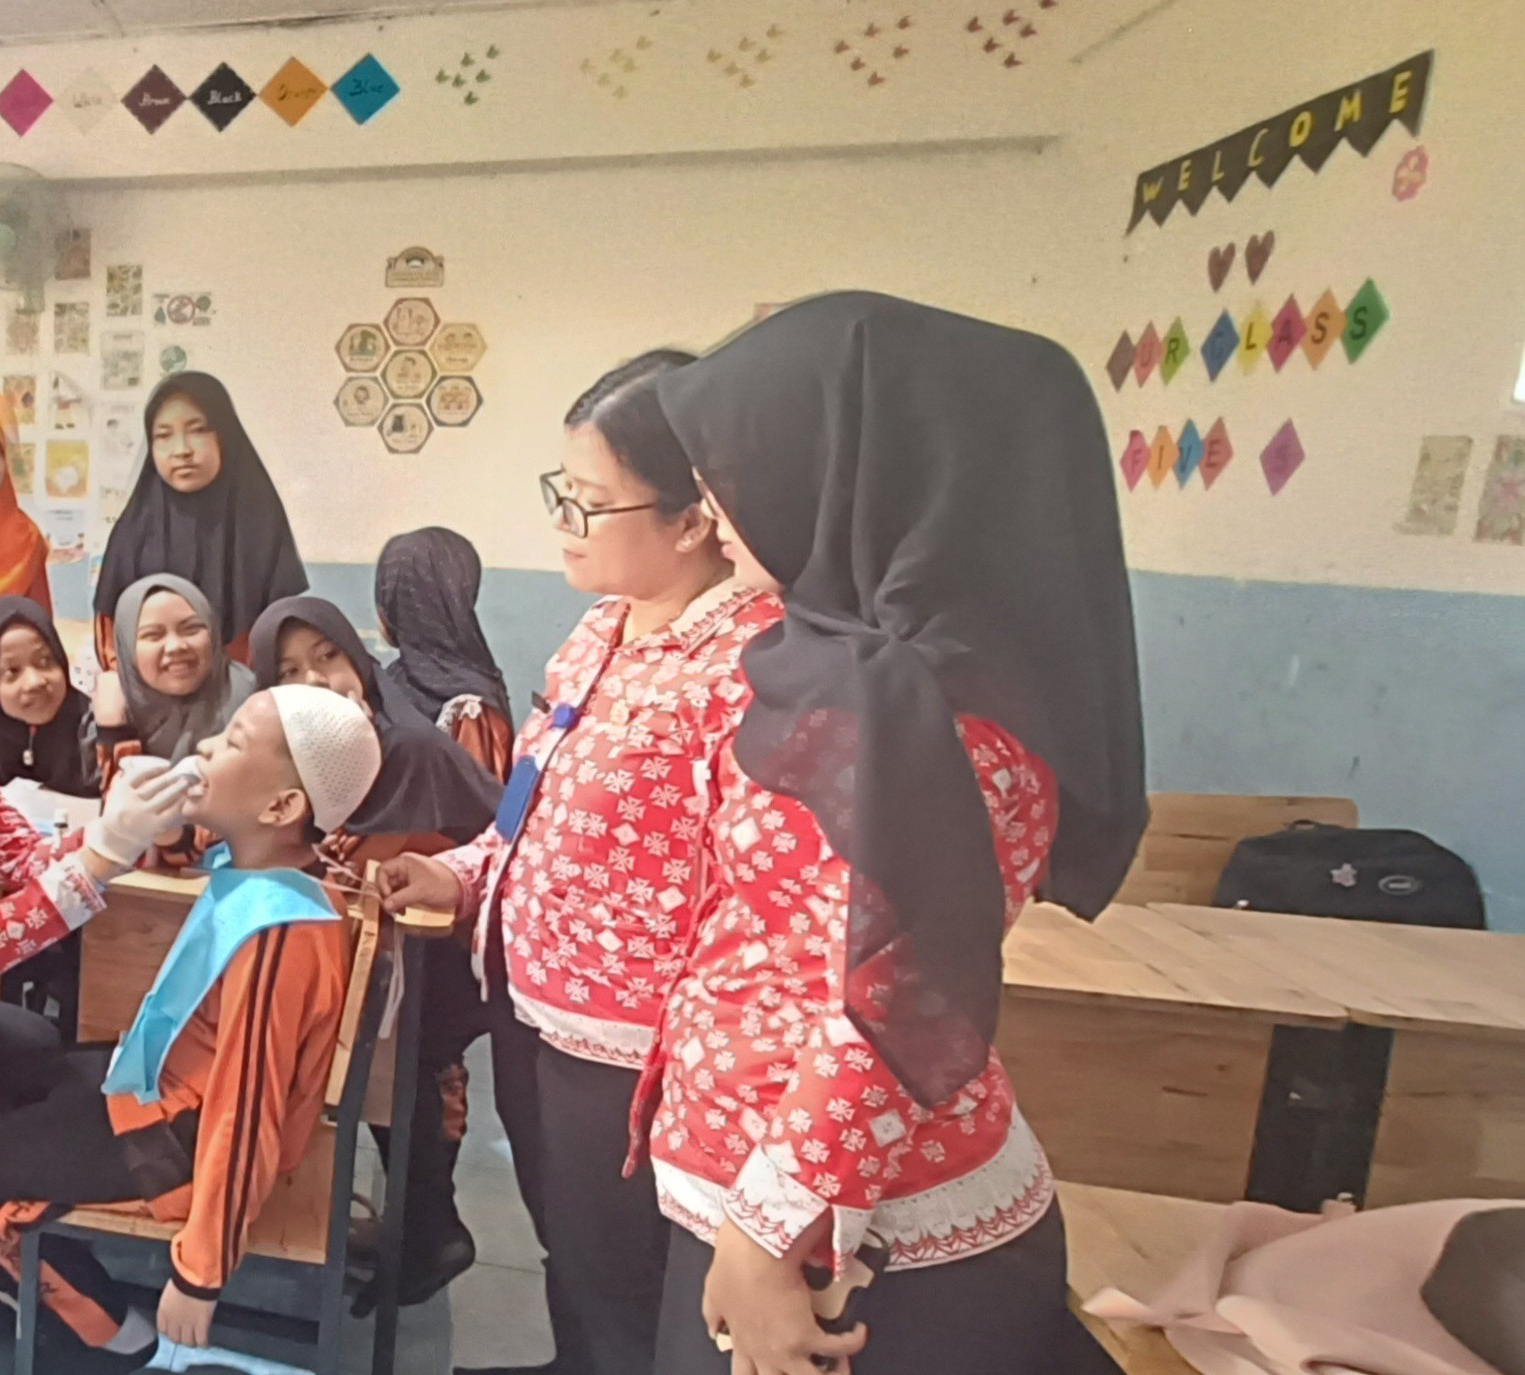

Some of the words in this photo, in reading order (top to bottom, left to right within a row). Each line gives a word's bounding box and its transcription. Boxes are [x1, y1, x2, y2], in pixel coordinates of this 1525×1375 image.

[207, 89, 243, 105] Black
[349, 78, 384, 97] Blue
[1142, 70, 1412, 205] WELCOME
[1211, 304, 1370, 361] CLASS
[1129, 438, 1223, 471] FIVE
